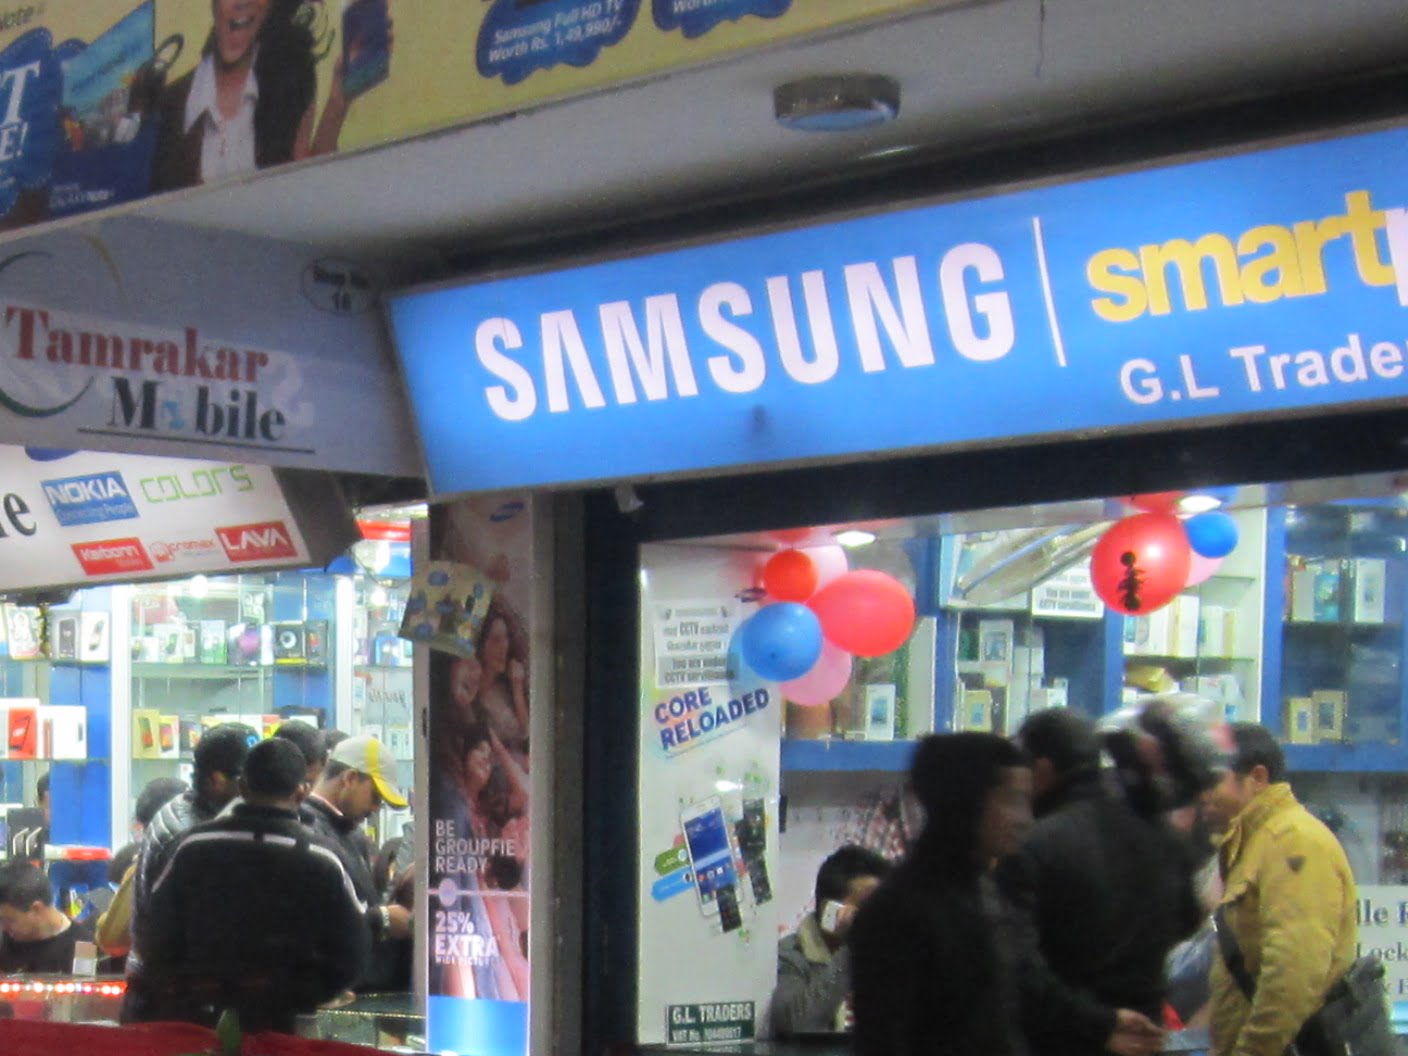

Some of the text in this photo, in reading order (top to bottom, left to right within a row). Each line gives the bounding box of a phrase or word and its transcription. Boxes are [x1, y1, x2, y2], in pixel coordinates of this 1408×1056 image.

[494, 19, 552, 46] Samsung
[488, 40, 530, 63] Worth
[4, 304, 270, 384] Tamrakar
[474, 241, 1016, 422] SAMSUNG
[1228, 332, 1408, 393] Trade
[44, 475, 128, 505] NOKIA
[219, 526, 290, 552] LAVA
[654, 686, 714, 725] CORE
[659, 688, 771, 752] RELOADED
[435, 819, 456, 838] BE
[435, 838, 517, 857] GROUPFIE
[435, 856, 489, 874] READY
[435, 911, 475, 934] 25%
[434, 934, 500, 959] EXTRA
[698, 1002, 752, 1024] TRADERS
